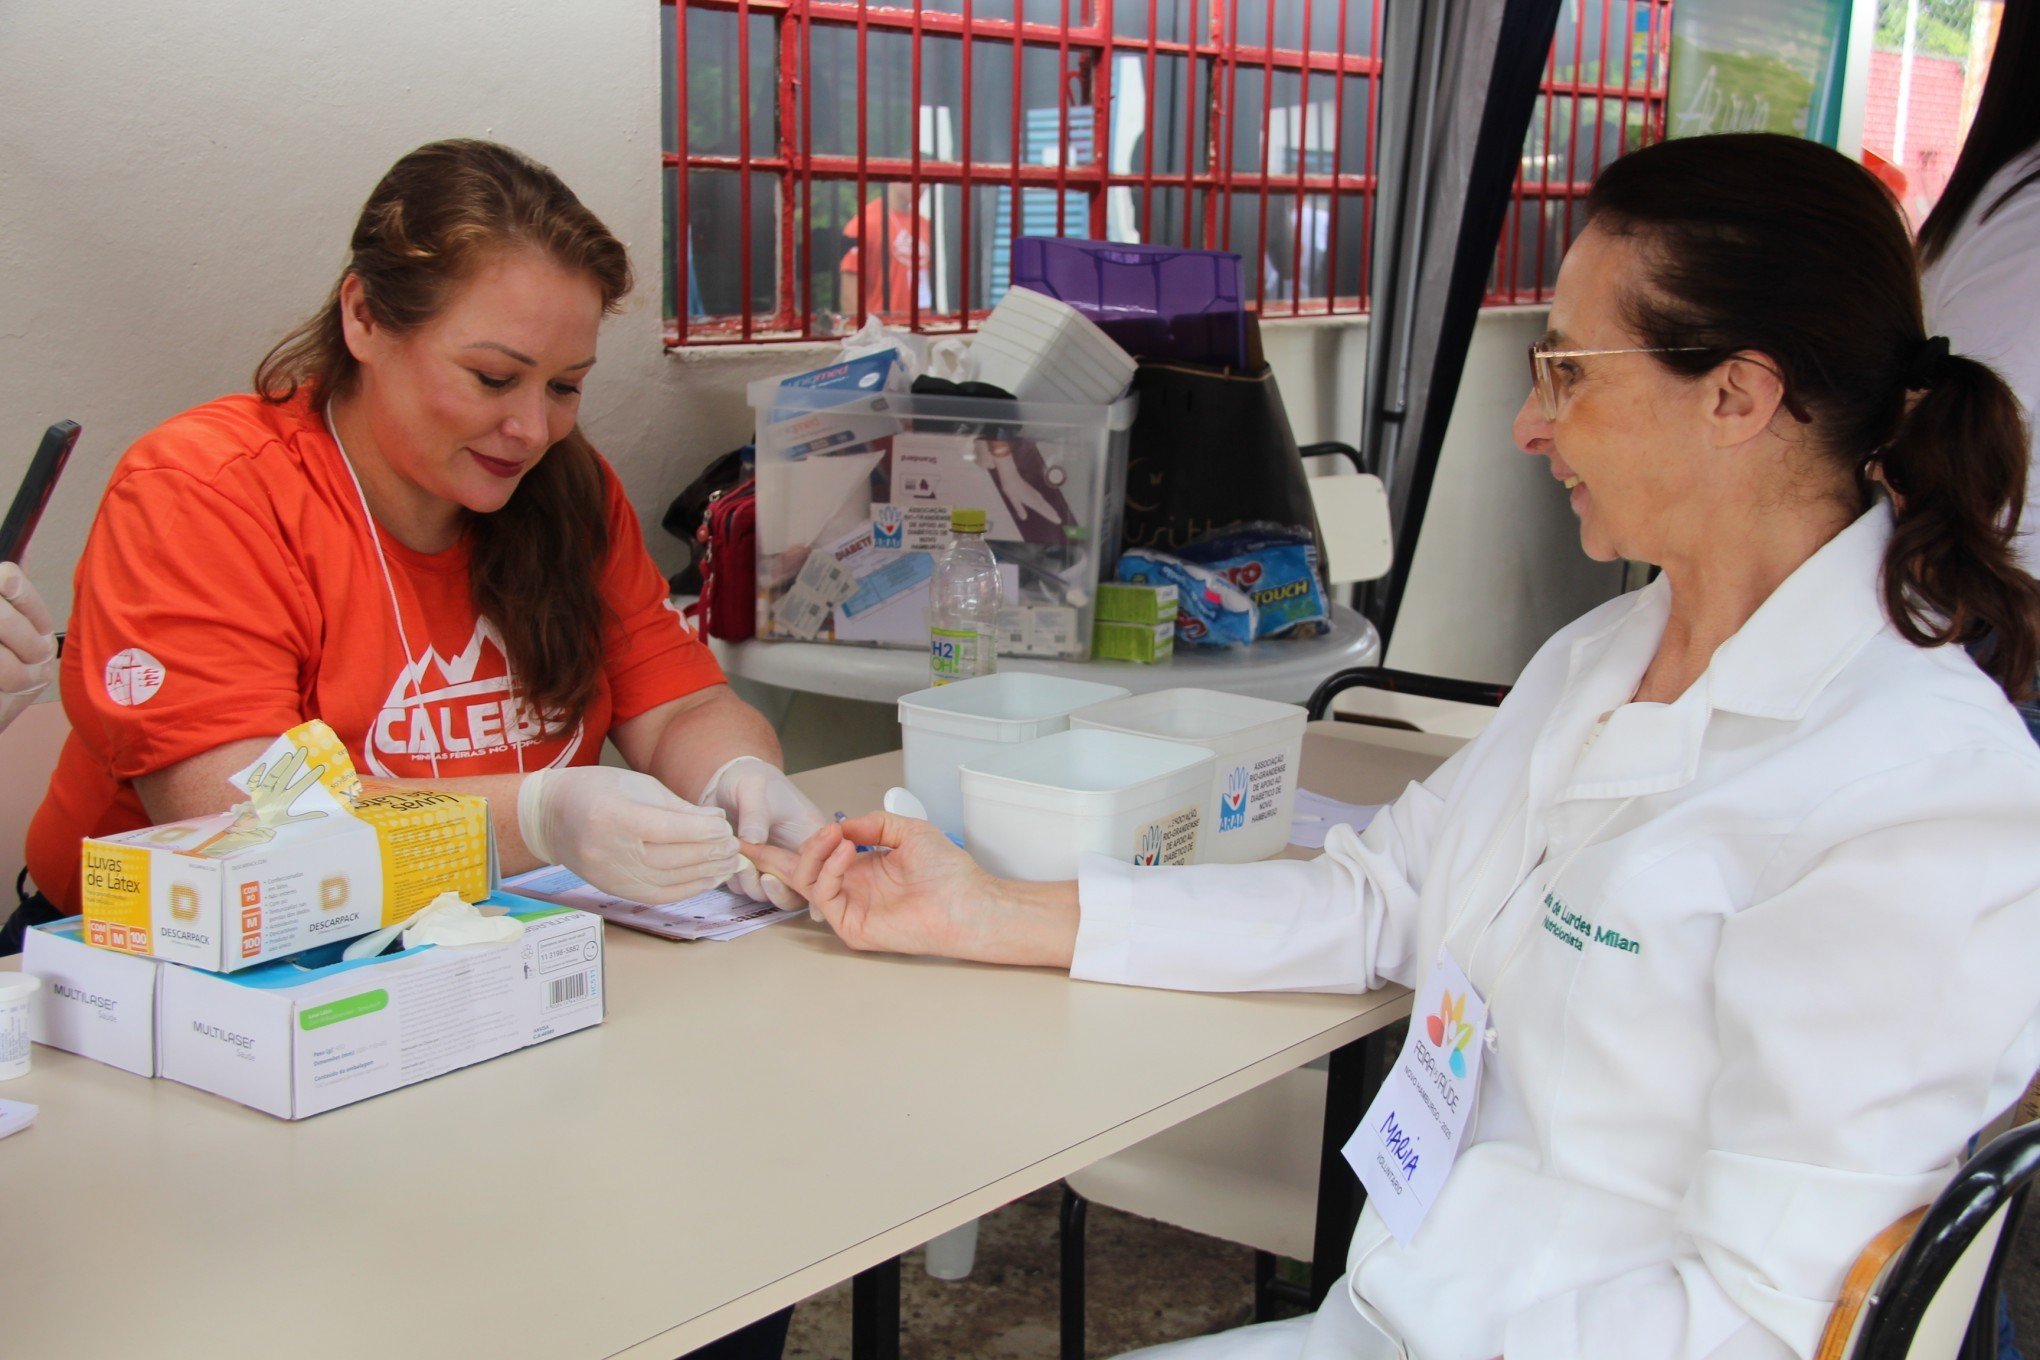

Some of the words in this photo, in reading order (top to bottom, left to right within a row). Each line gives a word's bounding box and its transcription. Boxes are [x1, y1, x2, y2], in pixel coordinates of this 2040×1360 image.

[932, 641, 953, 659] H2
[489, 744, 508, 754] NO
[390, 794, 460, 812] Luvas
[1219, 813, 1244, 833] ARAD
[87, 851, 122, 872] Luvas
[87, 869, 103, 887] de
[107, 873, 140, 894] Látex
[246, 917, 258, 928] M
[309, 912, 360, 932] DESCARPACK
[1552, 899, 1561, 916] de
[1561, 905, 1591, 936] Lurdes
[113, 933, 125, 945] M
[130, 931, 147, 945] 100
[161, 927, 210, 945] DESCARPACK
[243, 937, 260, 949] 100
[1404, 1065, 1418, 1086] NOVO
[1416, 1082, 1440, 1121] HAMBURGO
